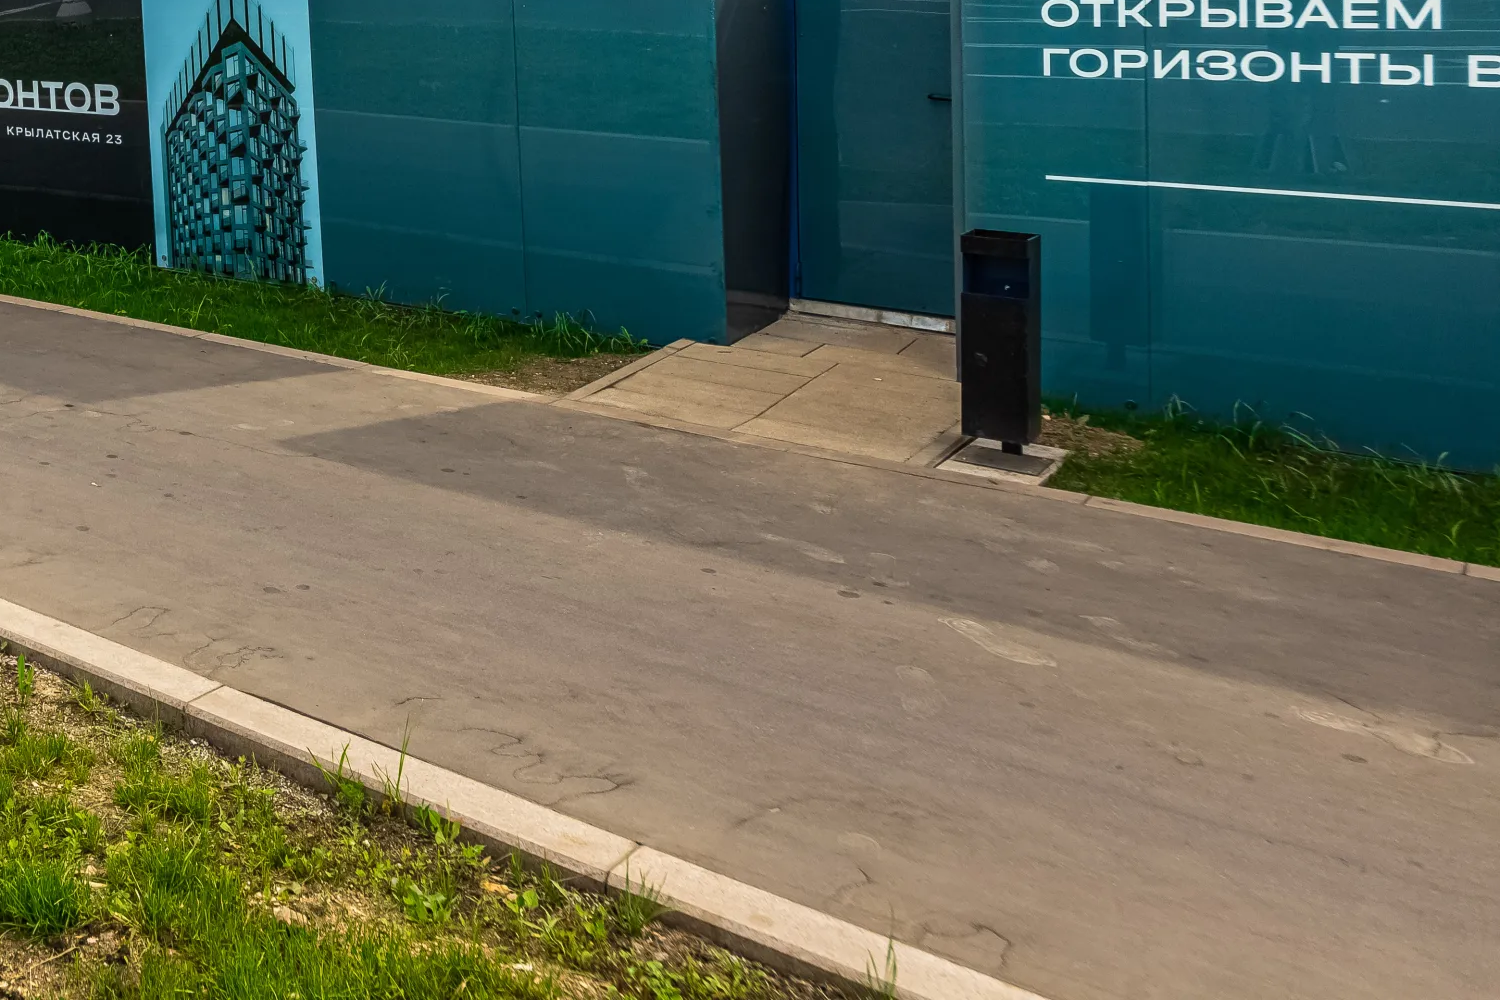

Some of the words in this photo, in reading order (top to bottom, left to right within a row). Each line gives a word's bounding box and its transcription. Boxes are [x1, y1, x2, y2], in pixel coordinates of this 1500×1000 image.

[1042, 48, 1434, 86] ГОРИЗОНТЫ
[6, 126, 100, 143] КРЫЛАТСКАЯ
[106, 134, 123, 145] 23
